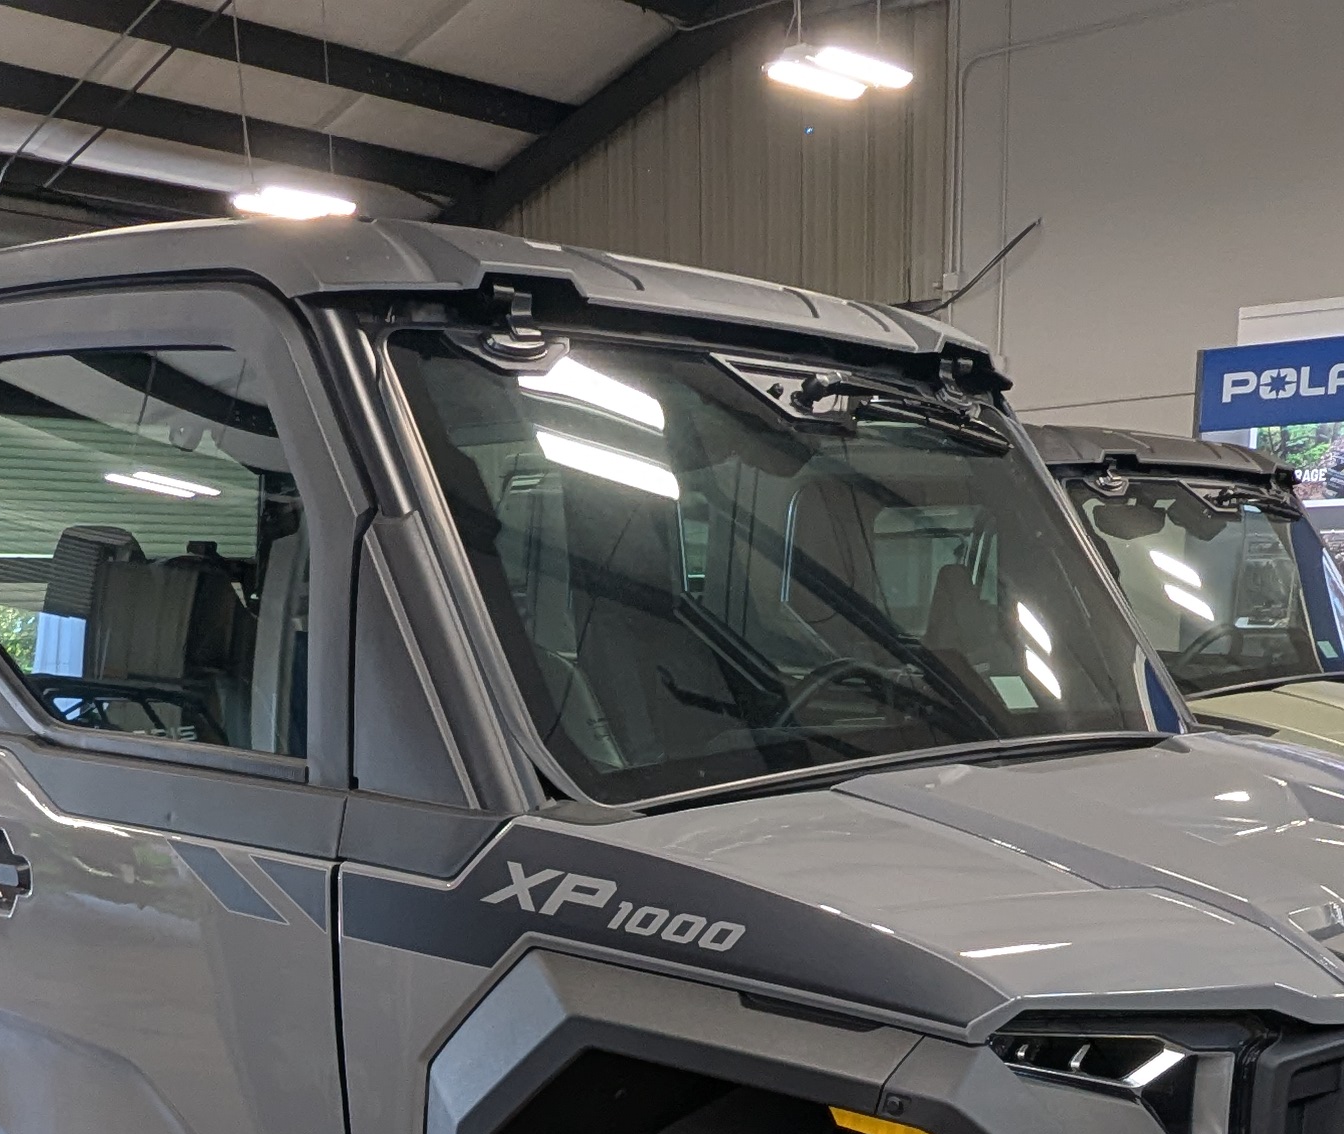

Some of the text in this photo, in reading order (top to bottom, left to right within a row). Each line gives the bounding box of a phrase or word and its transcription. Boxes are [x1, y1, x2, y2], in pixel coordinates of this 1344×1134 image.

[1294, 468, 1328, 483] RAGE
[480, 860, 746, 952] XP 1000
